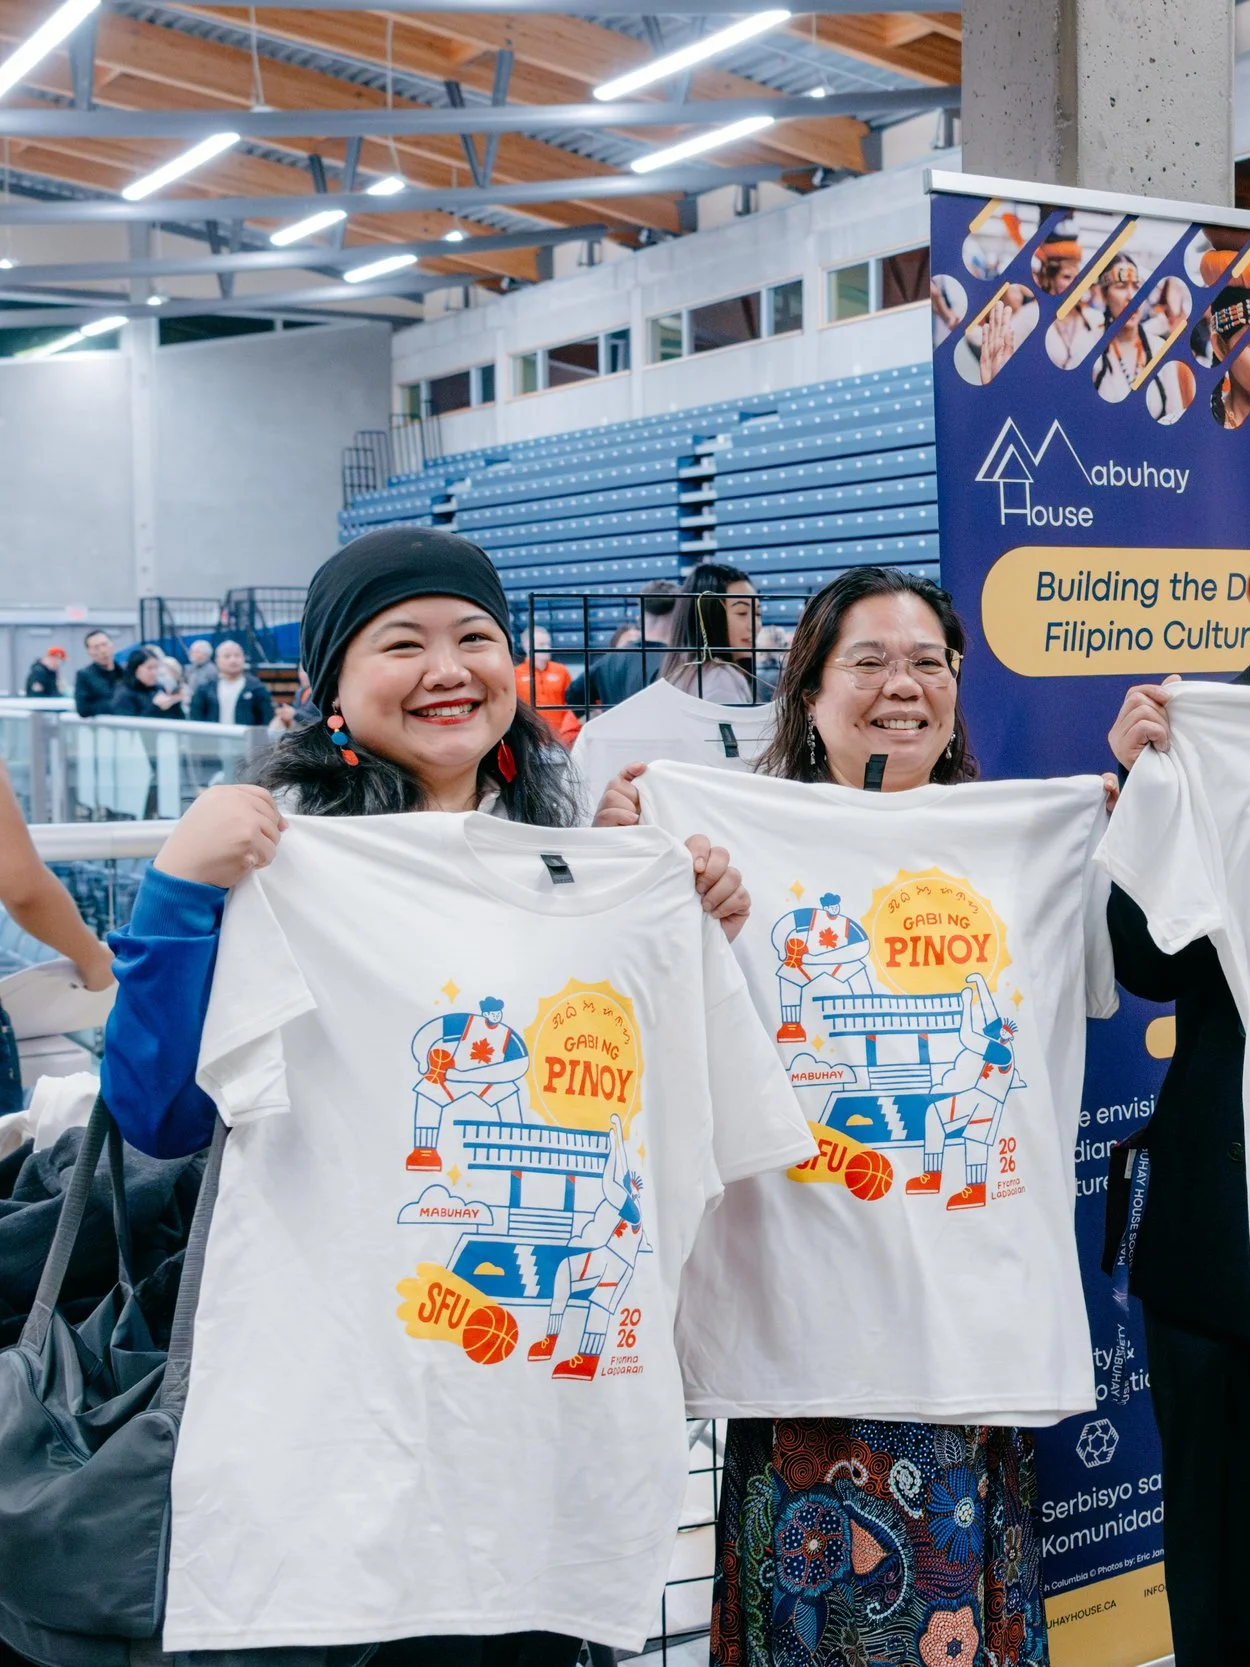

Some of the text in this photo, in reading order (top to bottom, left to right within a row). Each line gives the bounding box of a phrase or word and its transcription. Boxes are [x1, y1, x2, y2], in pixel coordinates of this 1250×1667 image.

[1000, 480, 1093, 527] House
[1036, 571, 1159, 609] Building
[1170, 572, 1217, 601] the
[1045, 621, 1153, 658] Filipino
[903, 913, 970, 931] GABI NG
[884, 933, 991, 968] PINOY
[564, 1034, 620, 1060] GABI NG
[542, 1056, 634, 1103] PINOY
[791, 1070, 844, 1081] MABUHAY
[999, 1137, 1017, 1155] 20
[999, 1156, 1017, 1174] 26
[419, 1208, 480, 1219] MABUHAY
[1130, 1188, 1144, 1231] HOUSE
[418, 1281, 470, 1330] SFU
[620, 1308, 642, 1326] 20
[617, 1328, 637, 1348] 26
[1042, 1473, 1162, 1522] Serbisyo sa
[1042, 1501, 1164, 1558] Komunidad
[1051, 1570, 1089, 1590] Columbia
[1097, 1561, 1124, 1575] Photos
[1136, 1553, 1151, 1563] Eric
[1144, 1583, 1166, 1597] INFO
